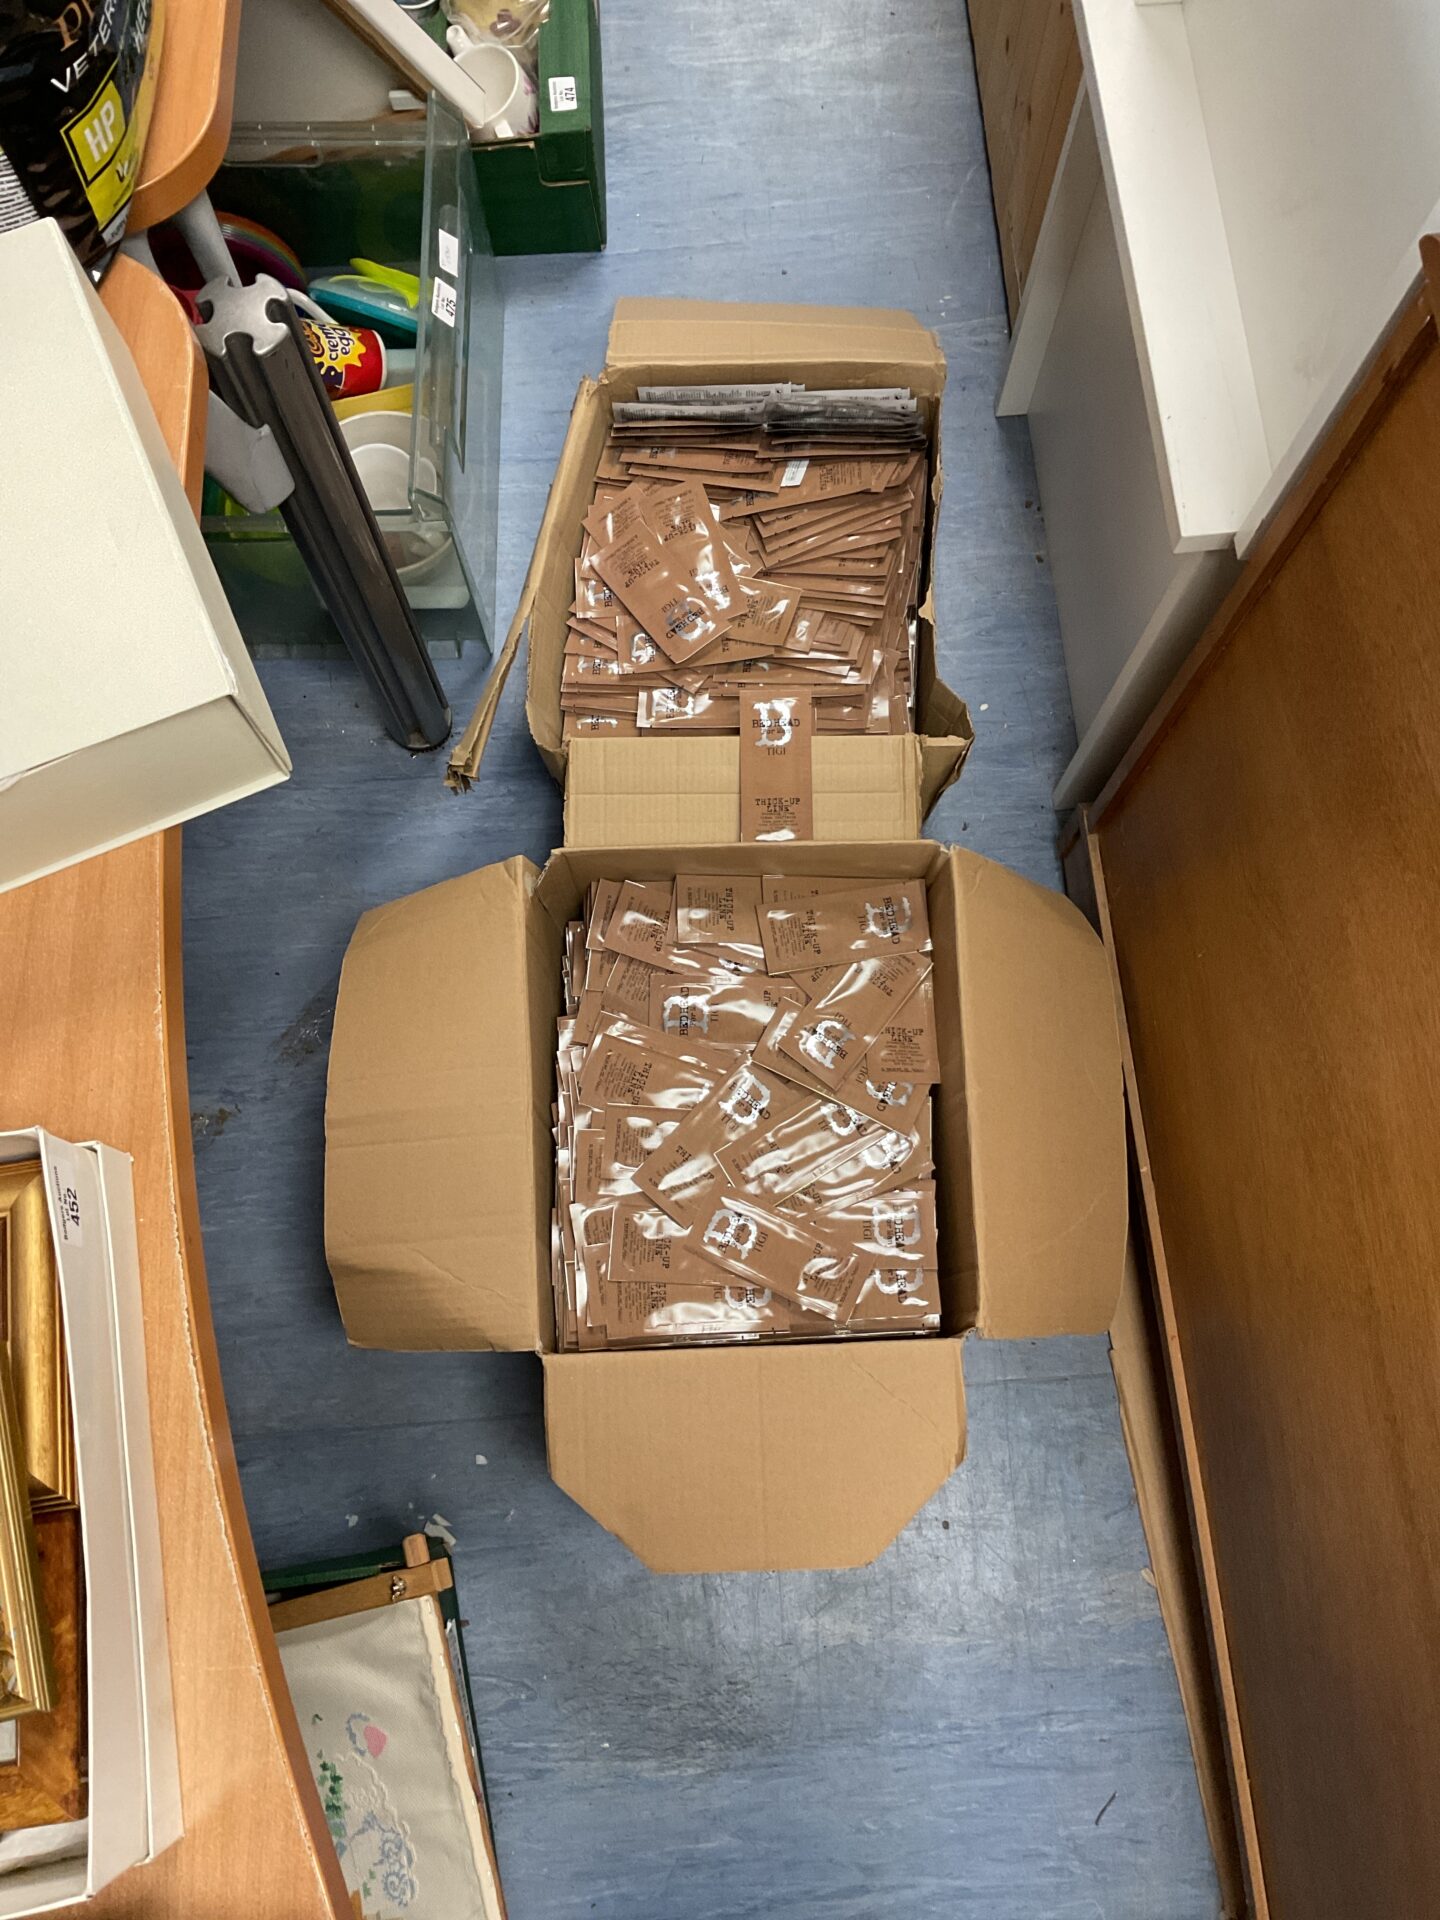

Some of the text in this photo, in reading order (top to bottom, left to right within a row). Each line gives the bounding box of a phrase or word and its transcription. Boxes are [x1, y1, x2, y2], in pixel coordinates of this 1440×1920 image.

[50, 0, 117, 93] VETER
[564, 87, 575, 102] 474
[84, 100, 115, 163] HP
[446, 297, 456, 317] 475
[332, 327, 355, 356] egg
[661, 598, 678, 613] TIGI
[767, 747, 786, 756] TIGI
[755, 797, 800, 806] THICK-UP
[726, 888, 734, 931] THICK-UP
[66, 1187, 80, 1228] 452
[862, 1220, 872, 1240] TIGI
[757, 1231, 768, 1252] TIGI
